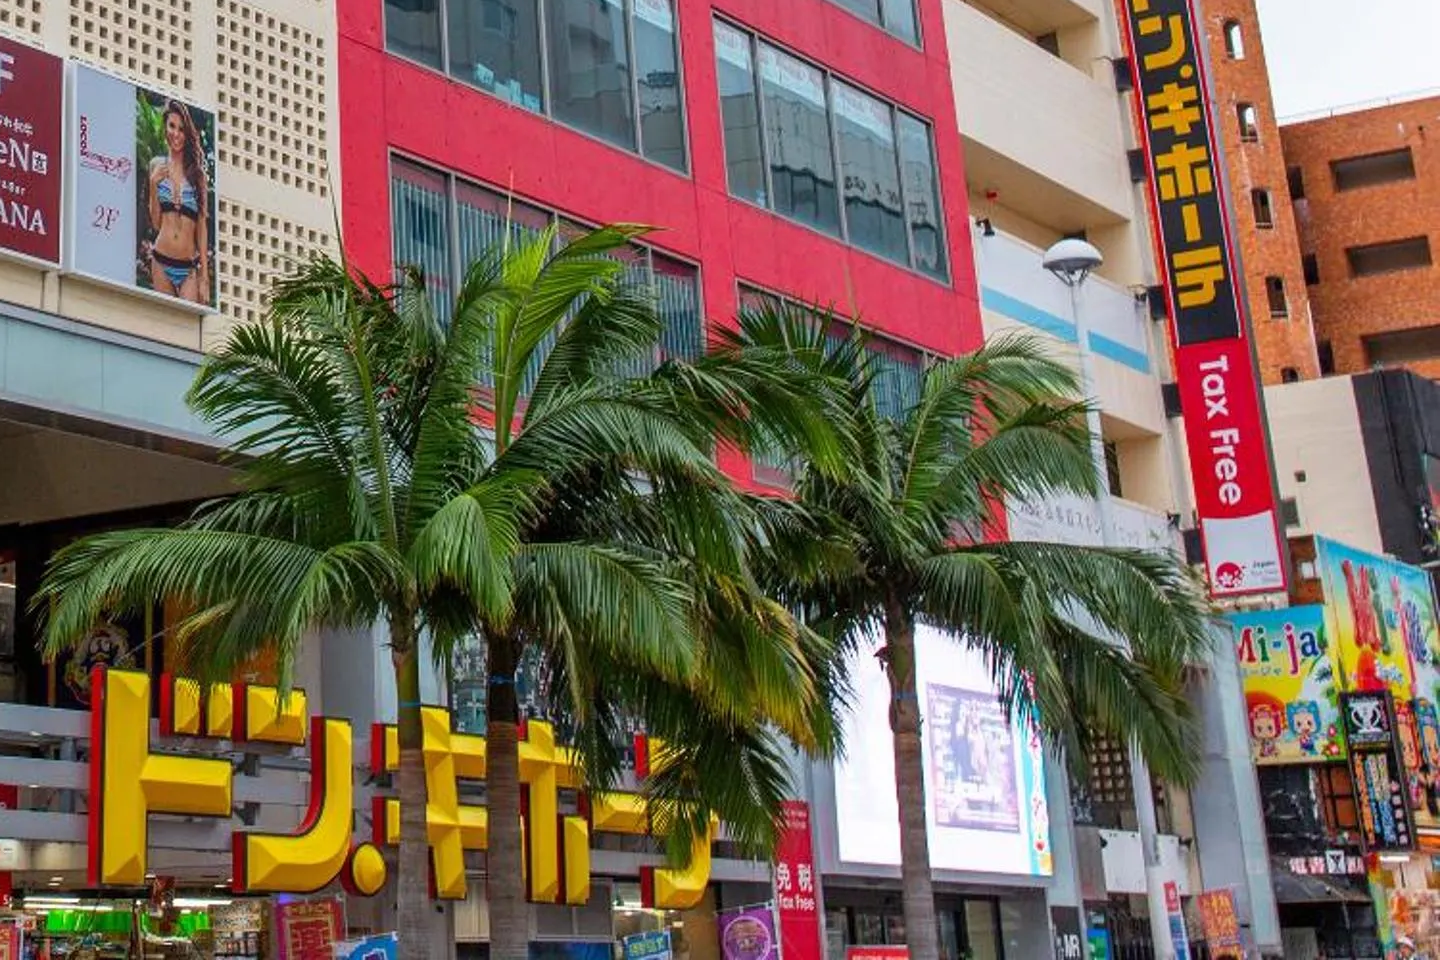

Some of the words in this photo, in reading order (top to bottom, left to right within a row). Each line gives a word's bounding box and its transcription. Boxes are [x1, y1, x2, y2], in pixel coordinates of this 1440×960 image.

[1199, 355, 1229, 420] Tax
[1210, 427, 1242, 506] Free
[777, 863, 813, 892] 免税
